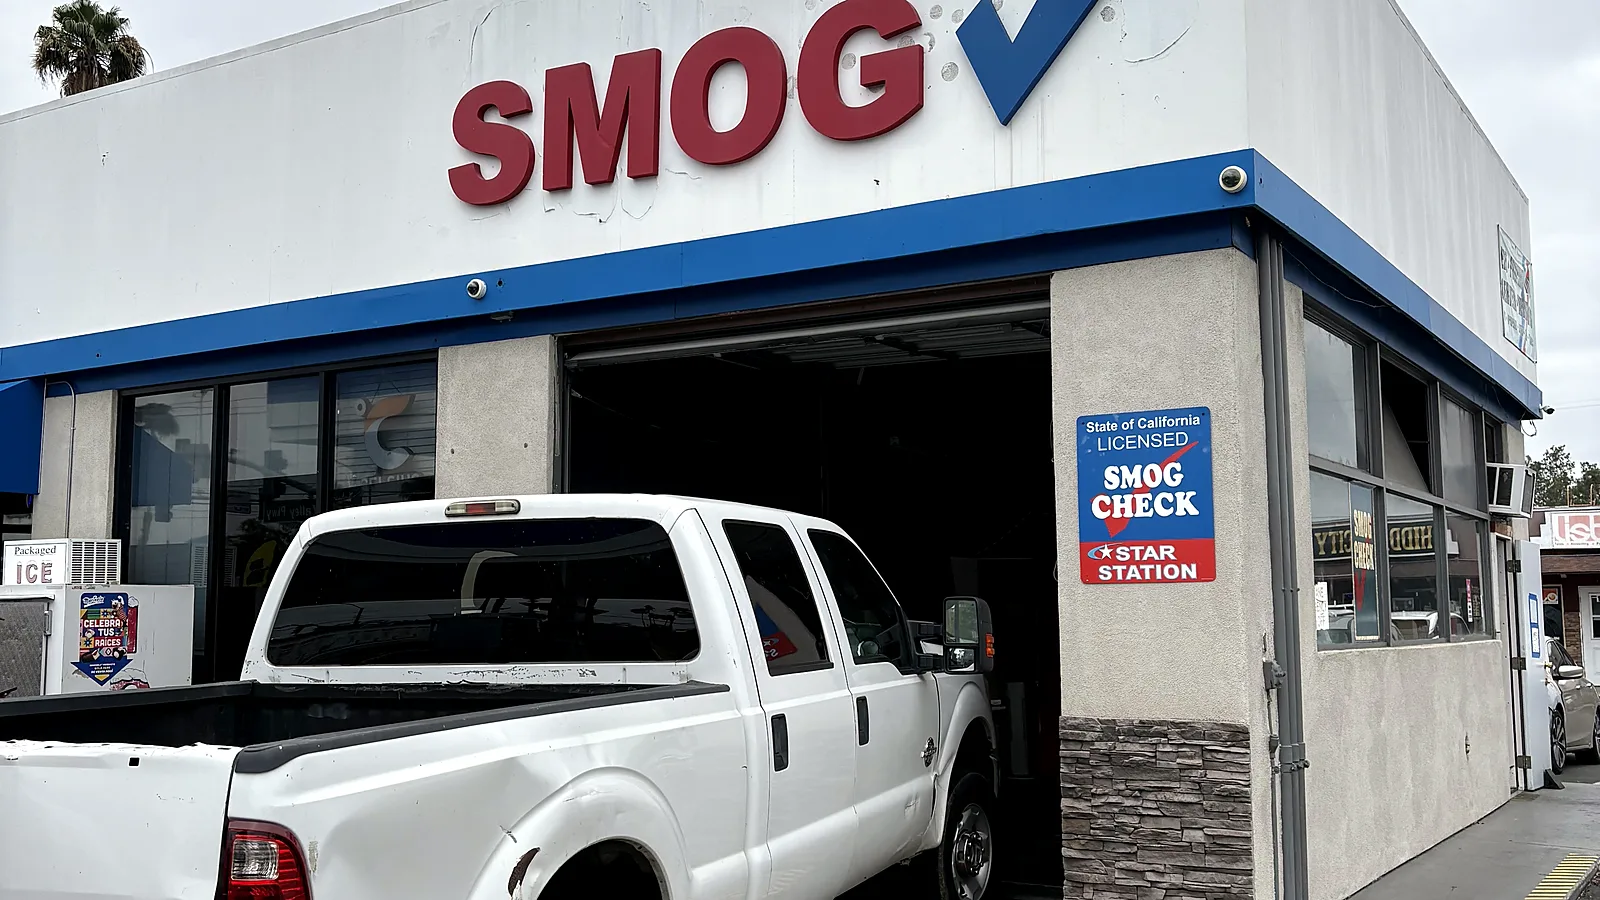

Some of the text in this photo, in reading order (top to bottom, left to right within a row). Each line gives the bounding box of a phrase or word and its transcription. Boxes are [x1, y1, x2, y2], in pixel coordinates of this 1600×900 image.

[448, 0, 924, 207] SMOG
[1086, 414, 1200, 433] State of California
[1097, 431, 1189, 451] LICENSED
[1104, 462, 1184, 490] SMOG
[1091, 491, 1200, 519] CHECK
[1353, 509, 1373, 539] SMOG
[14, 545, 57, 556] Packaged
[1115, 545, 1177, 561] STAR
[1353, 541, 1375, 571] CHECK
[16, 561, 53, 584] ICE
[1098, 563, 1197, 581] STATION
[83, 619, 121, 628] CELEBRA
[98, 628, 115, 636] TUS
